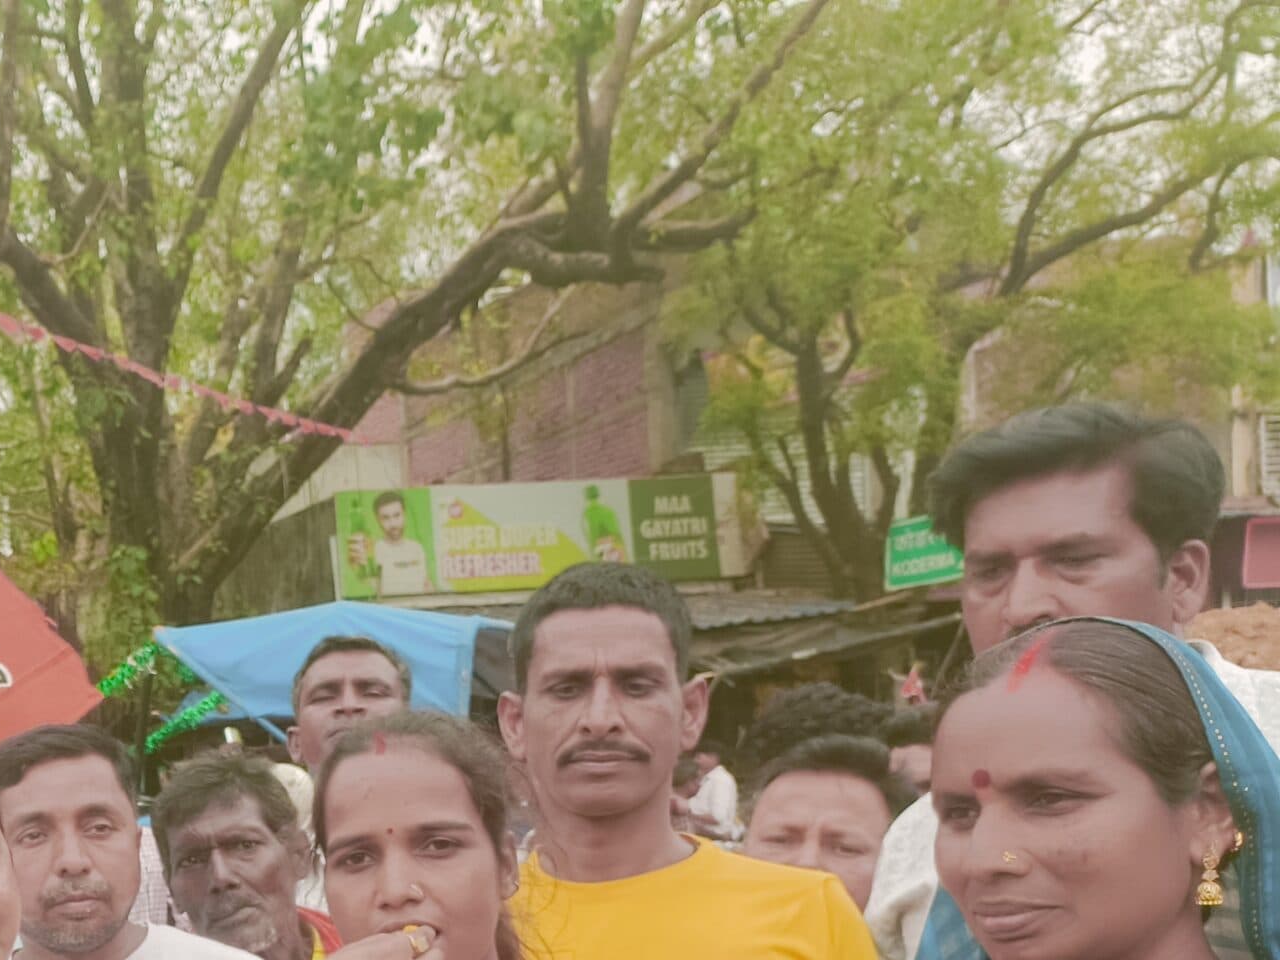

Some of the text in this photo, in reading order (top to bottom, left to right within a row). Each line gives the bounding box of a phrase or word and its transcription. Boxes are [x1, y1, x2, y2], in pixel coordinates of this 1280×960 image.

[654, 495, 691, 514] MAA
[441, 523, 558, 549] SUPER DUPER
[640, 517, 707, 539] GAYATRI
[649, 540, 708, 561] FRUITS
[443, 551, 541, 578] REFRESHER
[891, 551, 955, 576] KODERMA
